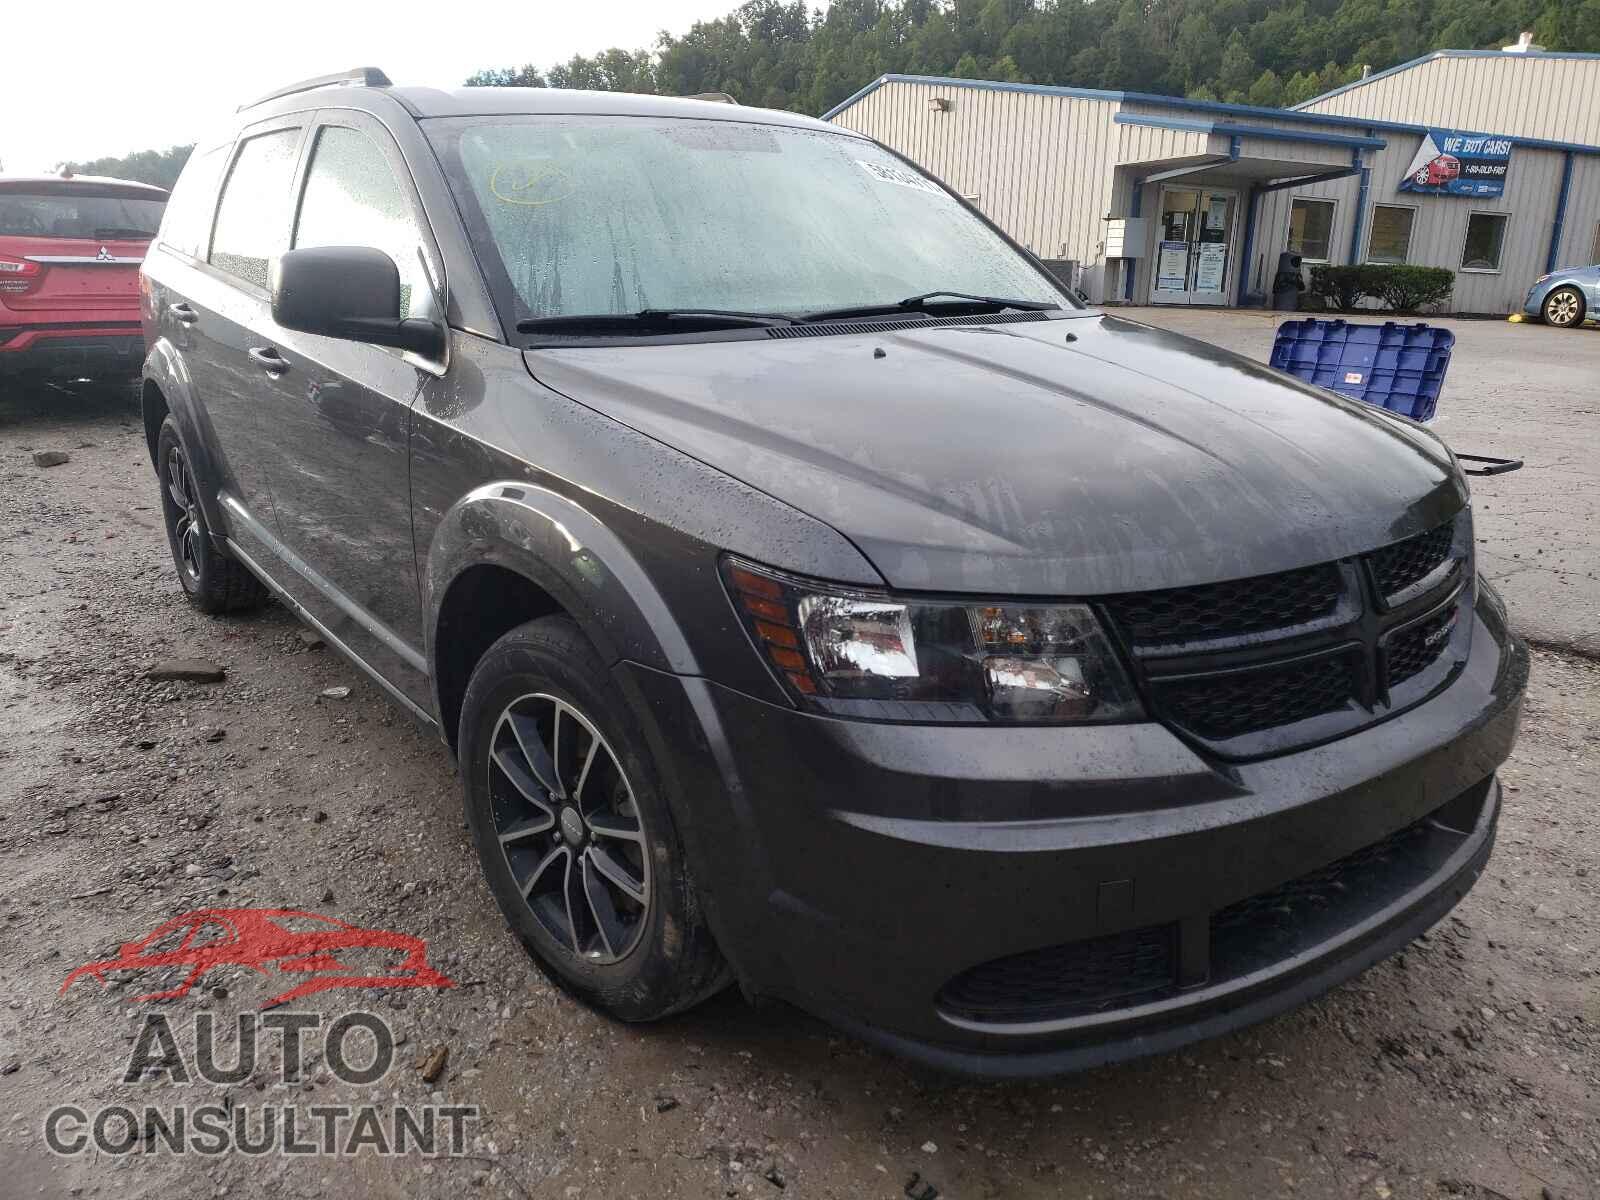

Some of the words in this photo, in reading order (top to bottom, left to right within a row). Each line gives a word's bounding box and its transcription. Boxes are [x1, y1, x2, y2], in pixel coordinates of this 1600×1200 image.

[1443, 137, 1462, 152] WE
[1463, 139, 1485, 153] BUY
[1483, 140, 1512, 155] CARS!
